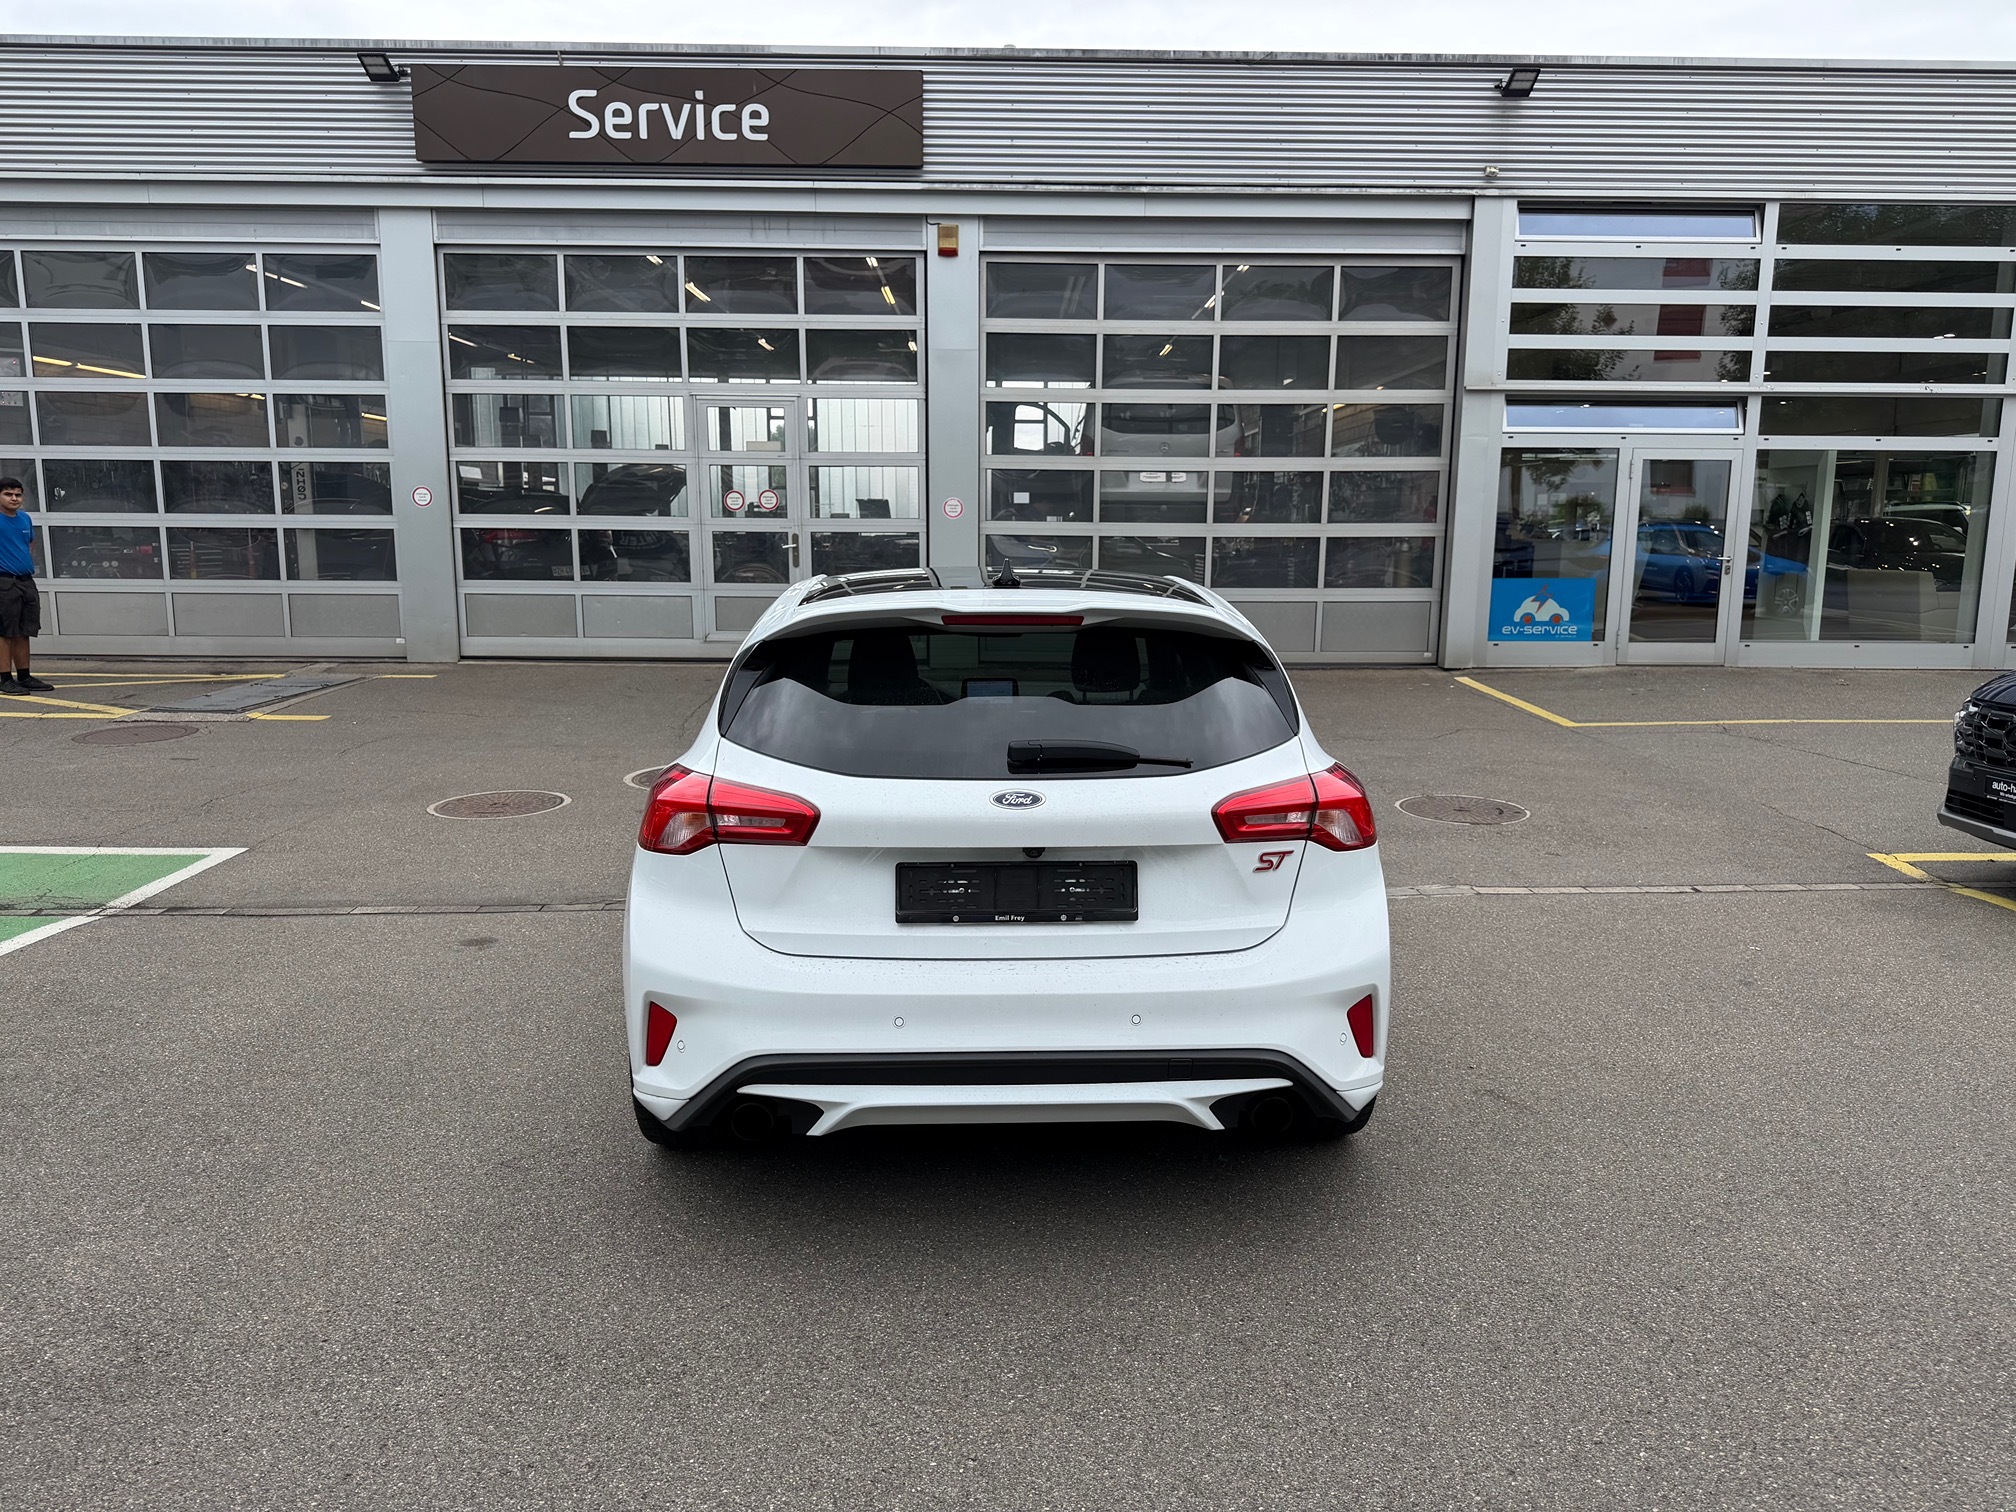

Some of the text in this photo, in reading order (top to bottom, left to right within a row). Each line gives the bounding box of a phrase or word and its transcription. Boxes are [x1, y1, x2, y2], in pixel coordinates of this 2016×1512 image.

[567, 89, 770, 141] Service
[1501, 625, 1578, 635] ev-service
[1002, 793, 1033, 804] Ford
[1252, 850, 1295, 873] ST
[1010, 914, 1025, 922] Frey
